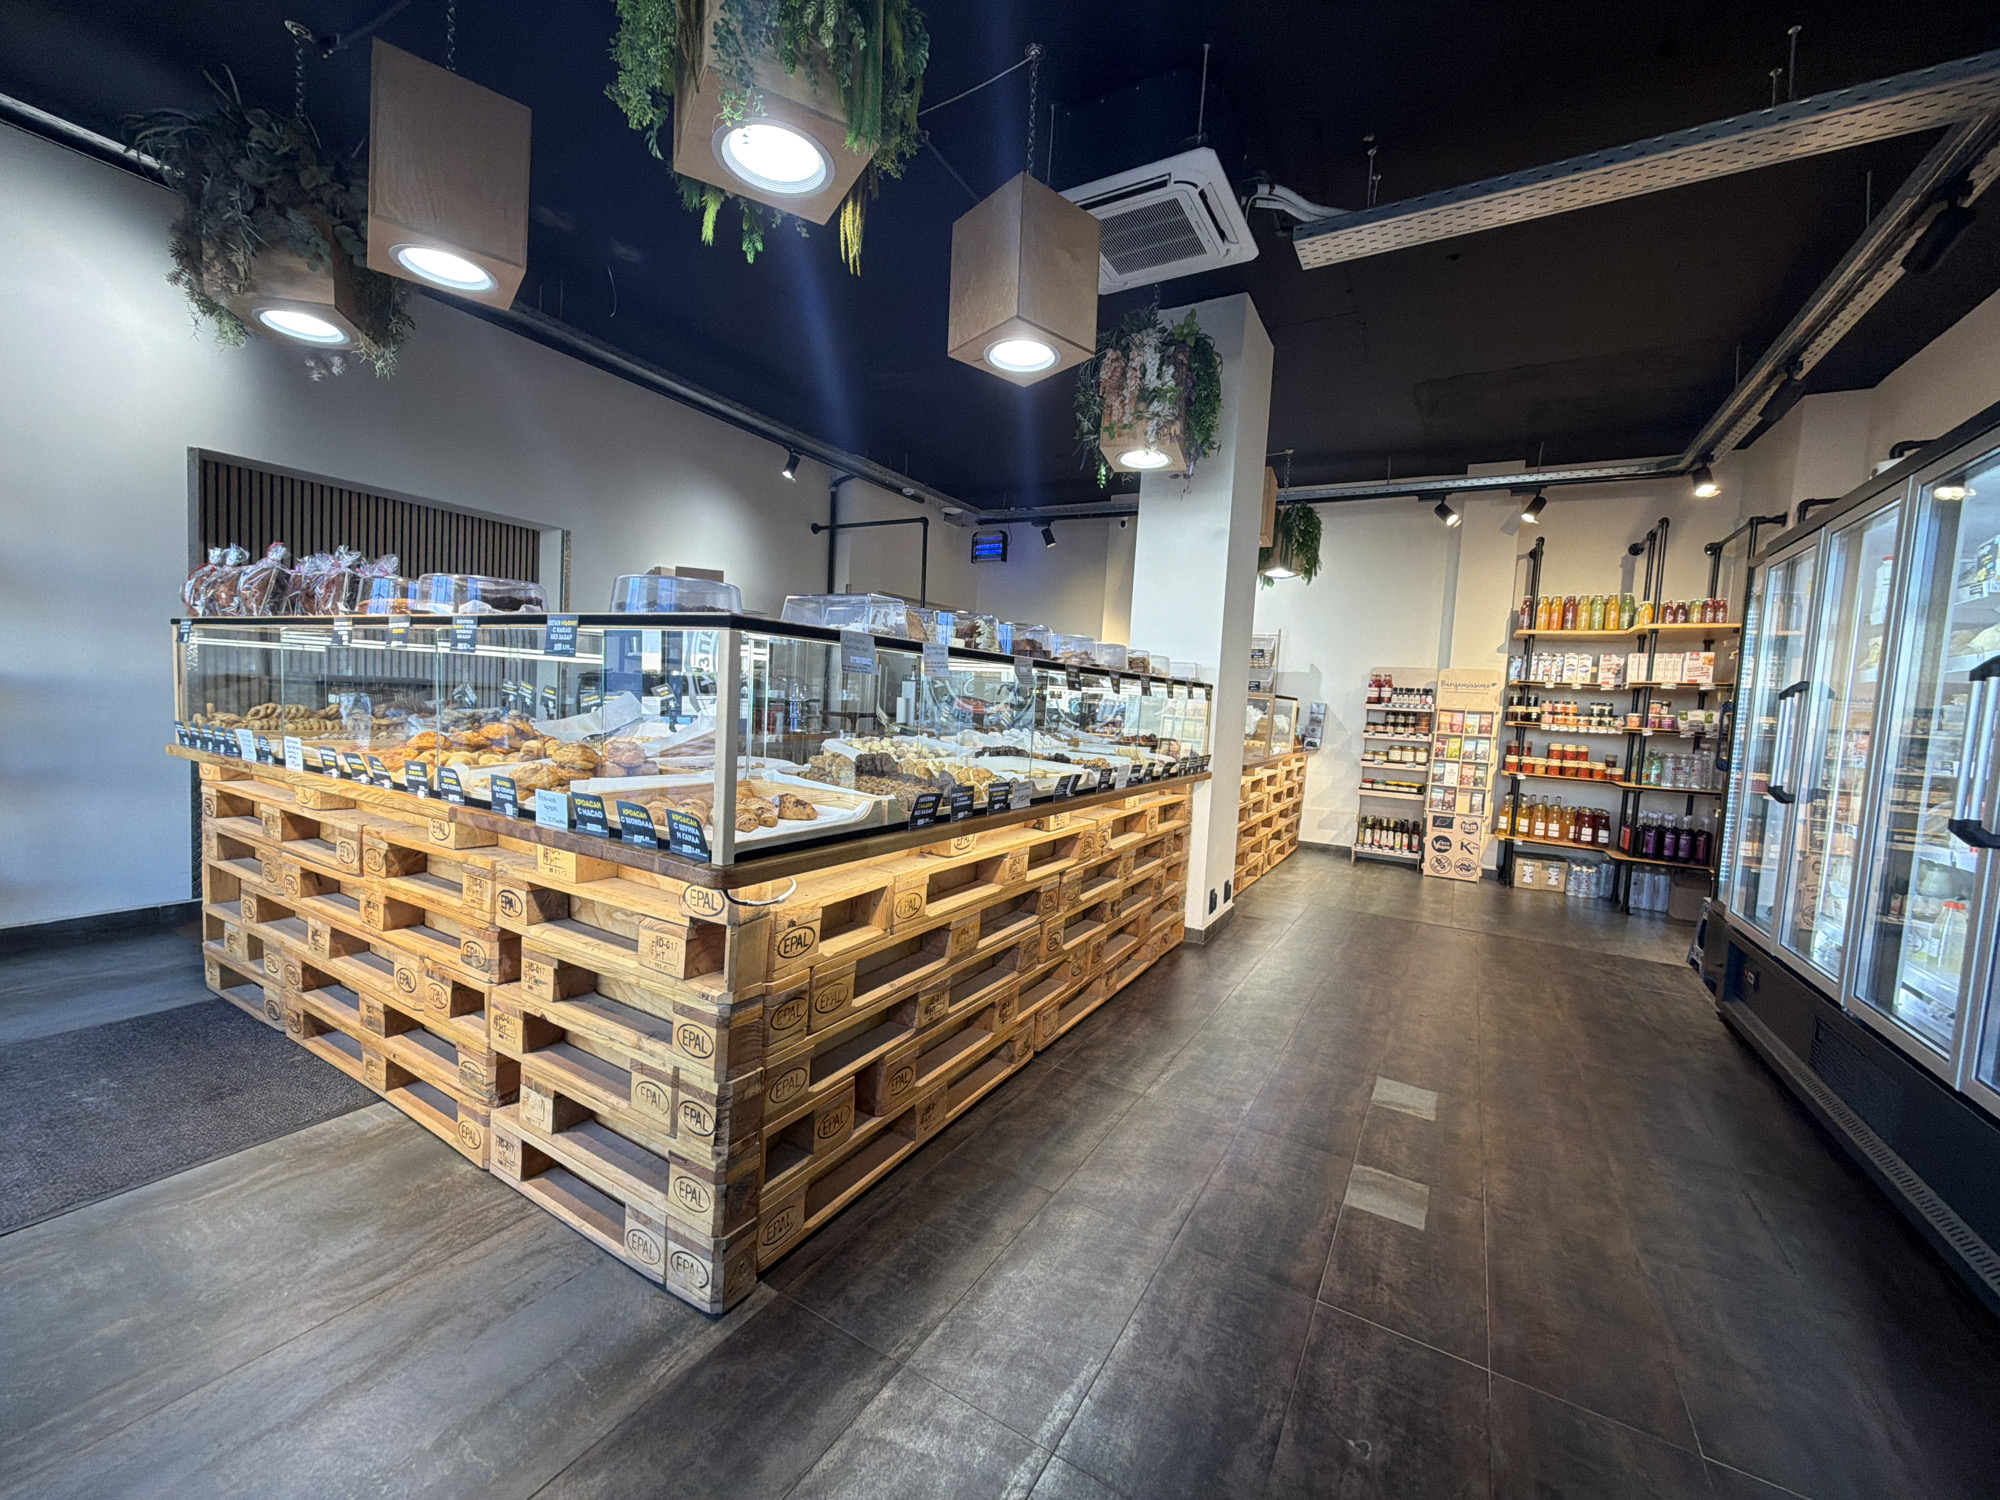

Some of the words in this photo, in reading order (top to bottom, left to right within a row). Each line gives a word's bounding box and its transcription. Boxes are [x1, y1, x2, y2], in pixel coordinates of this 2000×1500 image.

[575, 798, 602, 809] КРОАСАН
[582, 808, 603, 819] МАСЛО
[622, 808, 647, 819] КРОАСАН
[625, 816, 654, 829] ШОКОЛАД
[671, 813, 698, 826] КРОАСАН
[679, 824, 700, 837] ШУНКА
[501, 894, 519, 913] EPAL
[690, 889, 717, 911] EPAL
[784, 933, 808, 952] EPAL
[399, 972, 414, 989] EPAL
[820, 991, 843, 1008] EPAL
[777, 1004, 802, 1025] EPAL
[682, 1030, 709, 1053] EPAL
[775, 1073, 800, 1097] EPAL
[890, 1073, 908, 1091] EPAL
[640, 1087, 665, 1110] EPAL
[684, 1106, 709, 1131] EPAL
[822, 1113, 843, 1135] EPAL
[461, 1125, 477, 1145] EPAL
[679, 1182, 703, 1207] EPAL
[631, 1234, 655, 1260] EPAL
